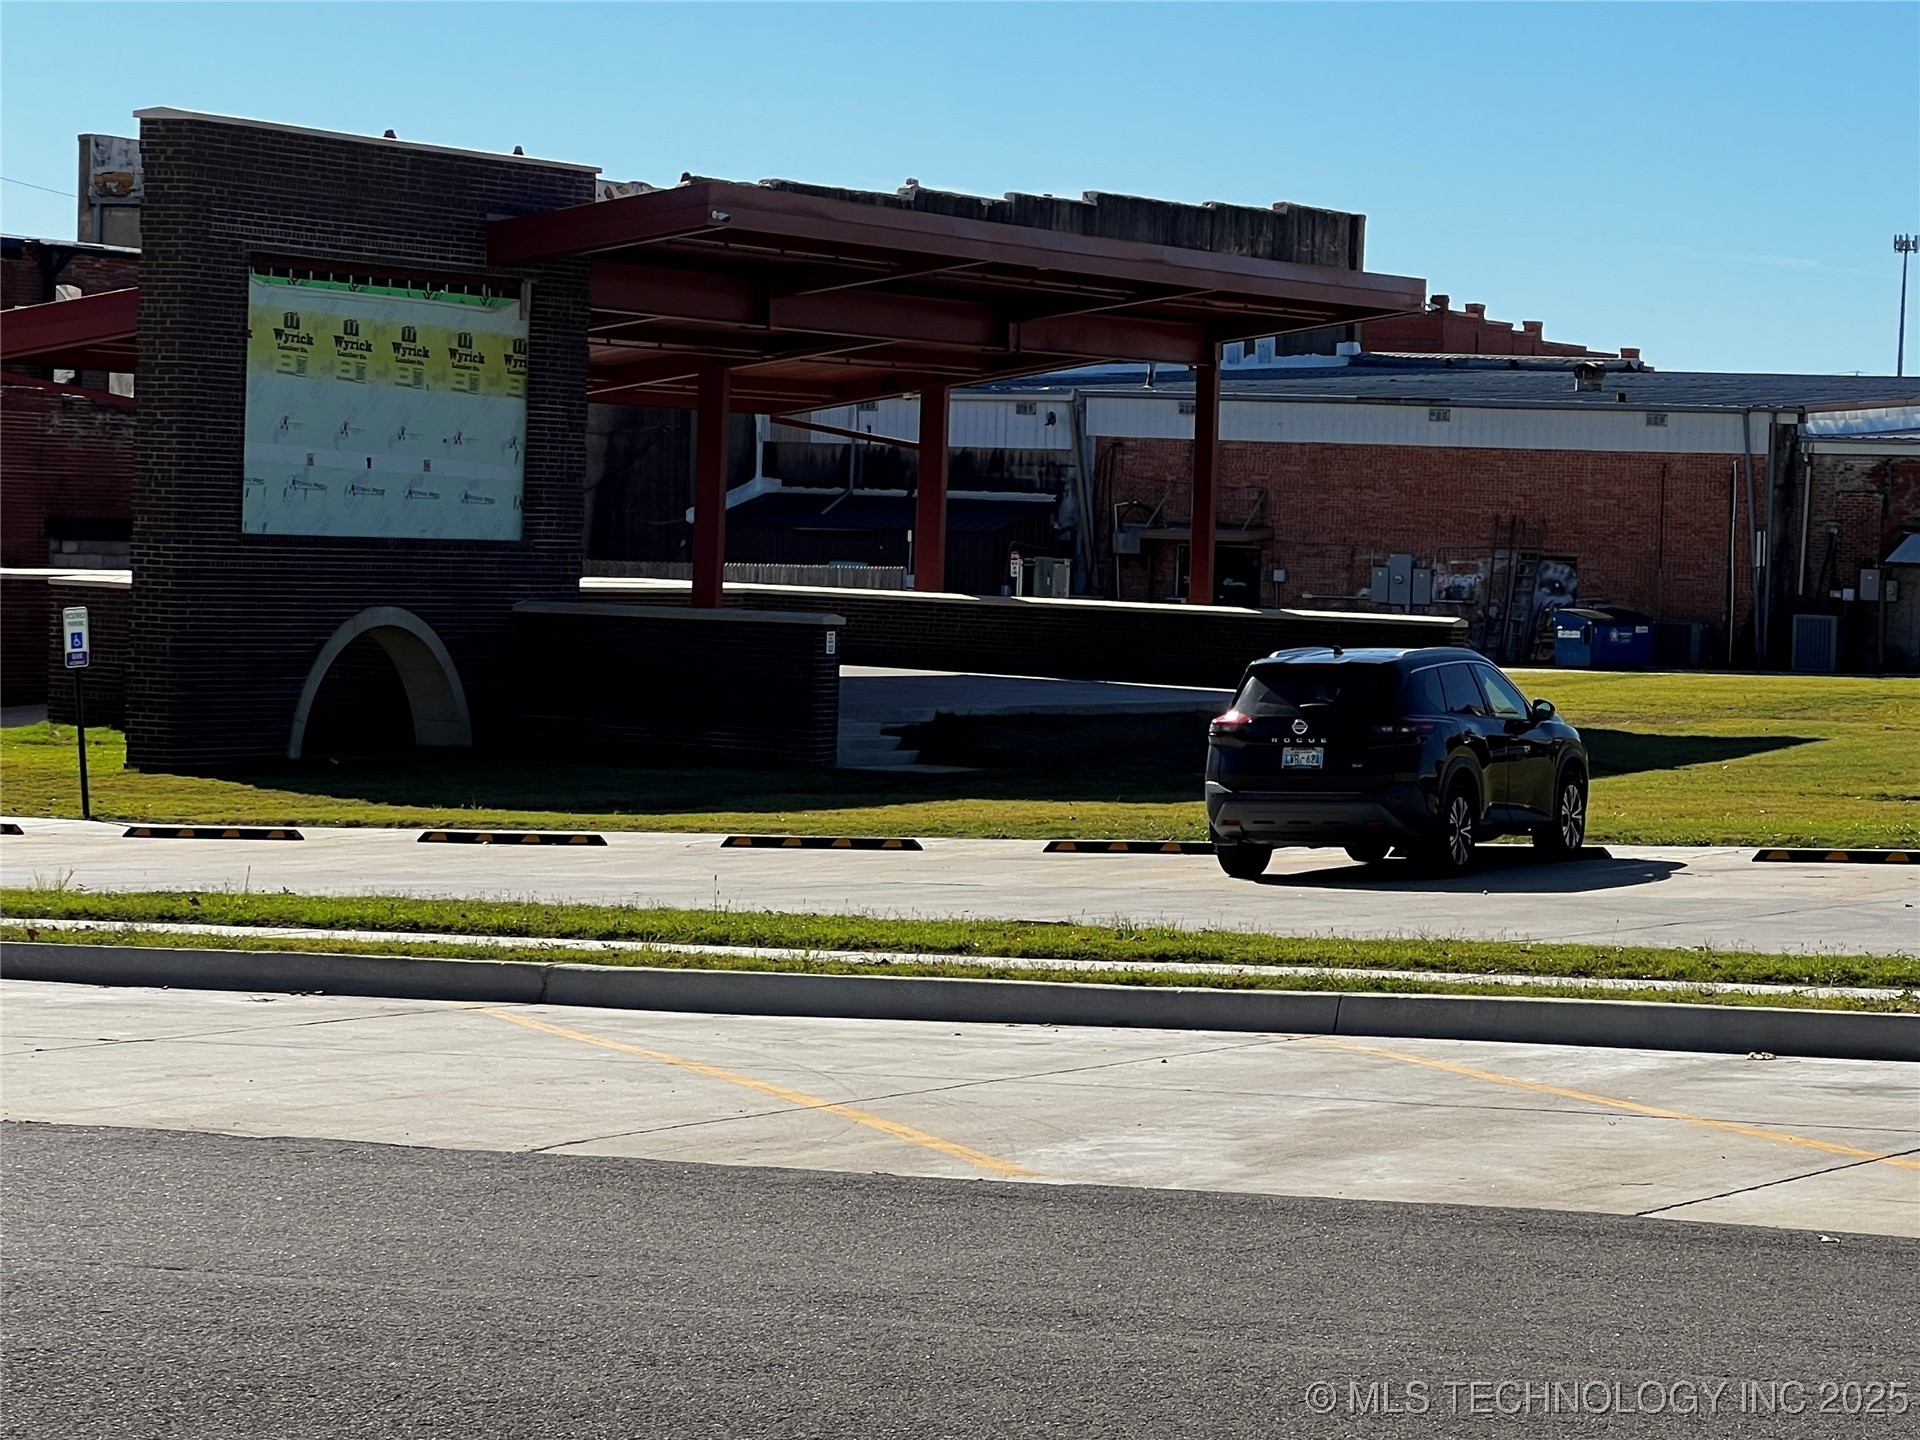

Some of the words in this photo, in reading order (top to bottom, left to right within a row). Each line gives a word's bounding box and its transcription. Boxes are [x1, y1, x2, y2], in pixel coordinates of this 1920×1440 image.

[273, 328, 314, 346] Wyrick
[333, 335, 373, 352] Wyrick
[391, 342, 430, 358] Wyrick
[448, 348, 485, 364] Wyrick
